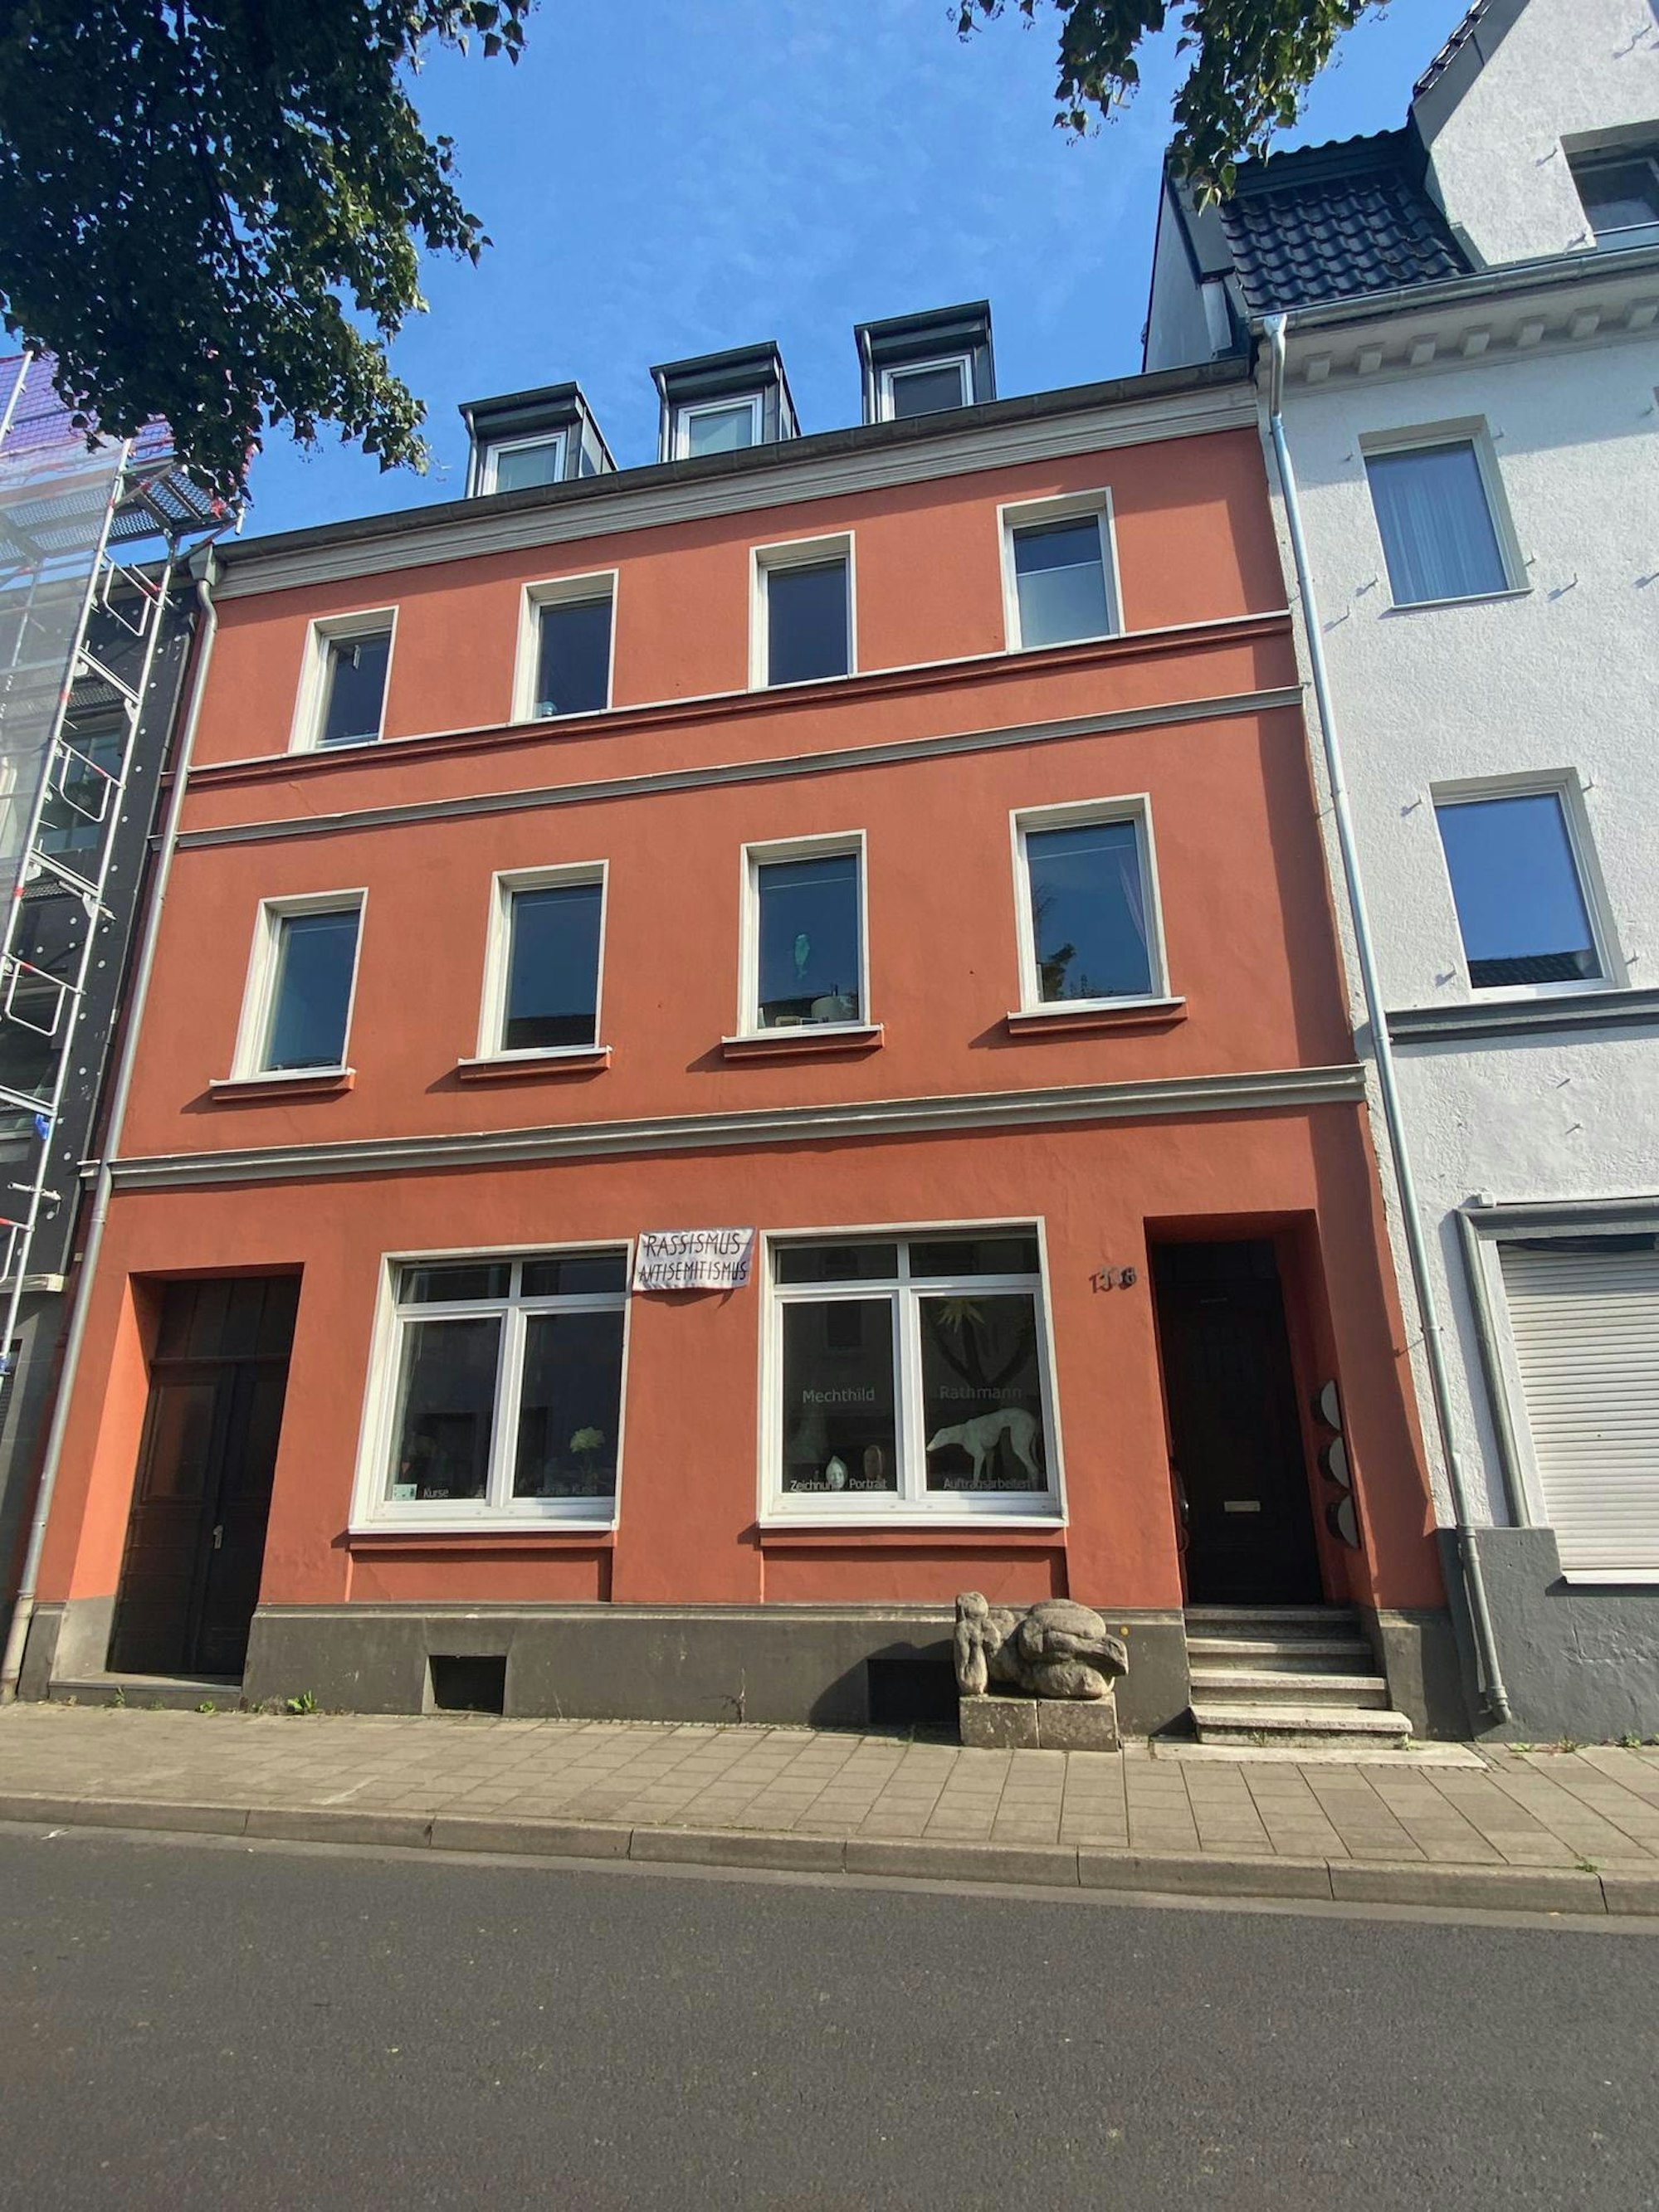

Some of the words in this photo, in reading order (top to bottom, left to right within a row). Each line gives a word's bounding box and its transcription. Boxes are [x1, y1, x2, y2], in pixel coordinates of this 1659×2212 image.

[646, 1233, 741, 1257] RASSISMUS
[639, 1261, 747, 1282] ANTISEMITISMUS
[803, 1387, 875, 1403] Mechthild
[939, 1385, 1022, 1400] Rathmann
